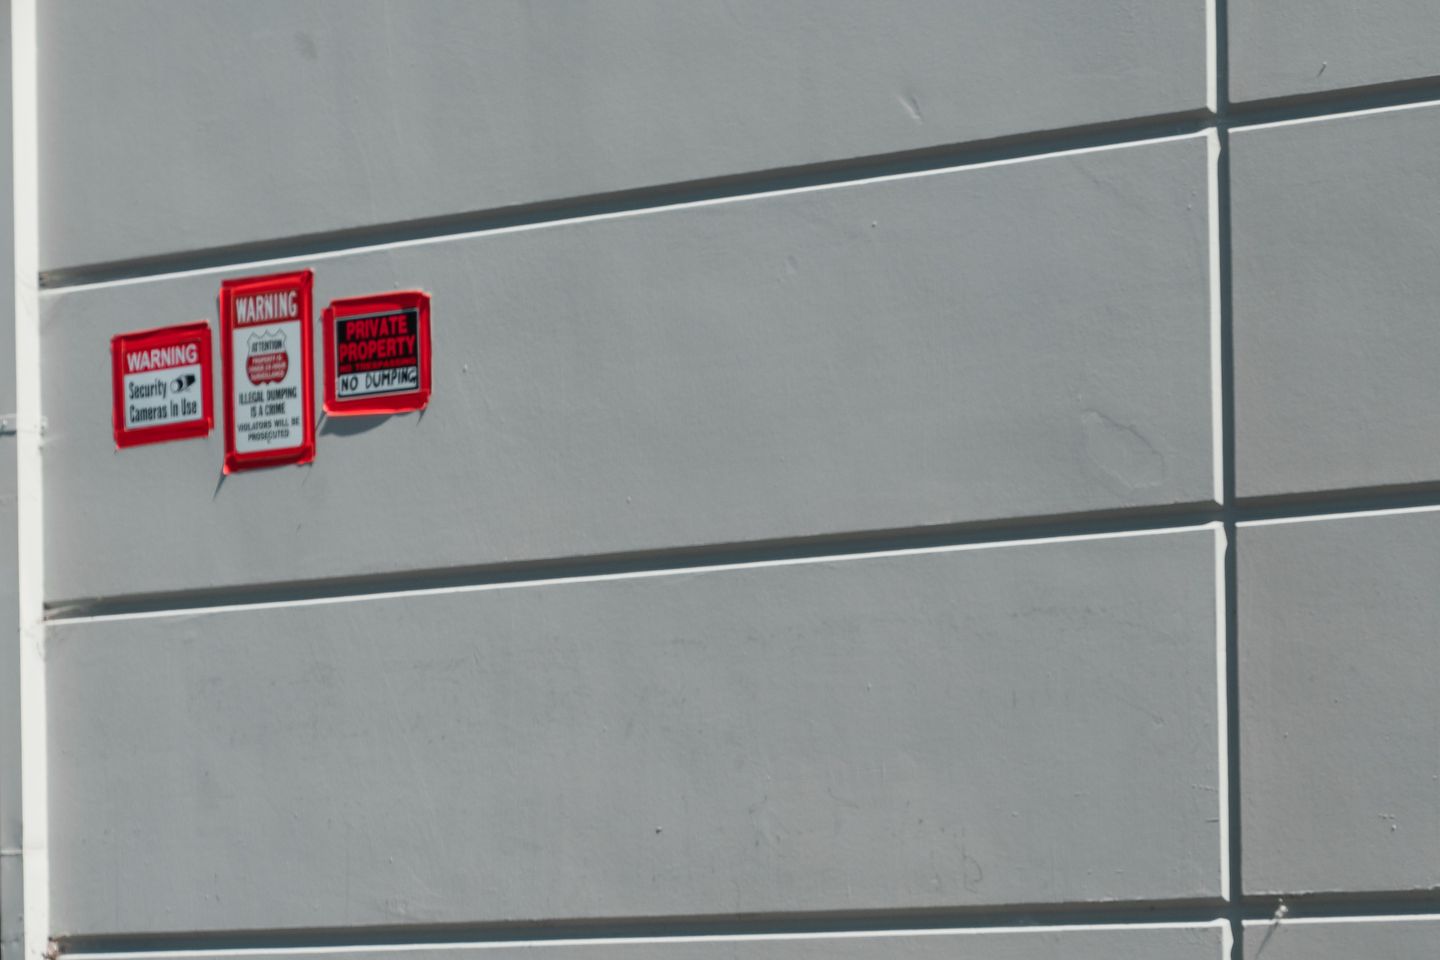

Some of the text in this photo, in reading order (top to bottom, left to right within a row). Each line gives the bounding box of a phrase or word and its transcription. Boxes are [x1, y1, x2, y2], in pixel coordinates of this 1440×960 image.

[236, 290, 297, 324] WARNING
[346, 315, 408, 339] PRIVATE
[127, 343, 198, 372] WARNING
[339, 335, 415, 361] PROPERTY
[129, 378, 167, 399] Security
[341, 367, 417, 391] NO DUMPING
[239, 386, 297, 405] ILLEGAL DUMPING
[130, 404, 167, 422] Cameras
[181, 398, 197, 416] Use
[250, 402, 285, 418] IS A CRIME
